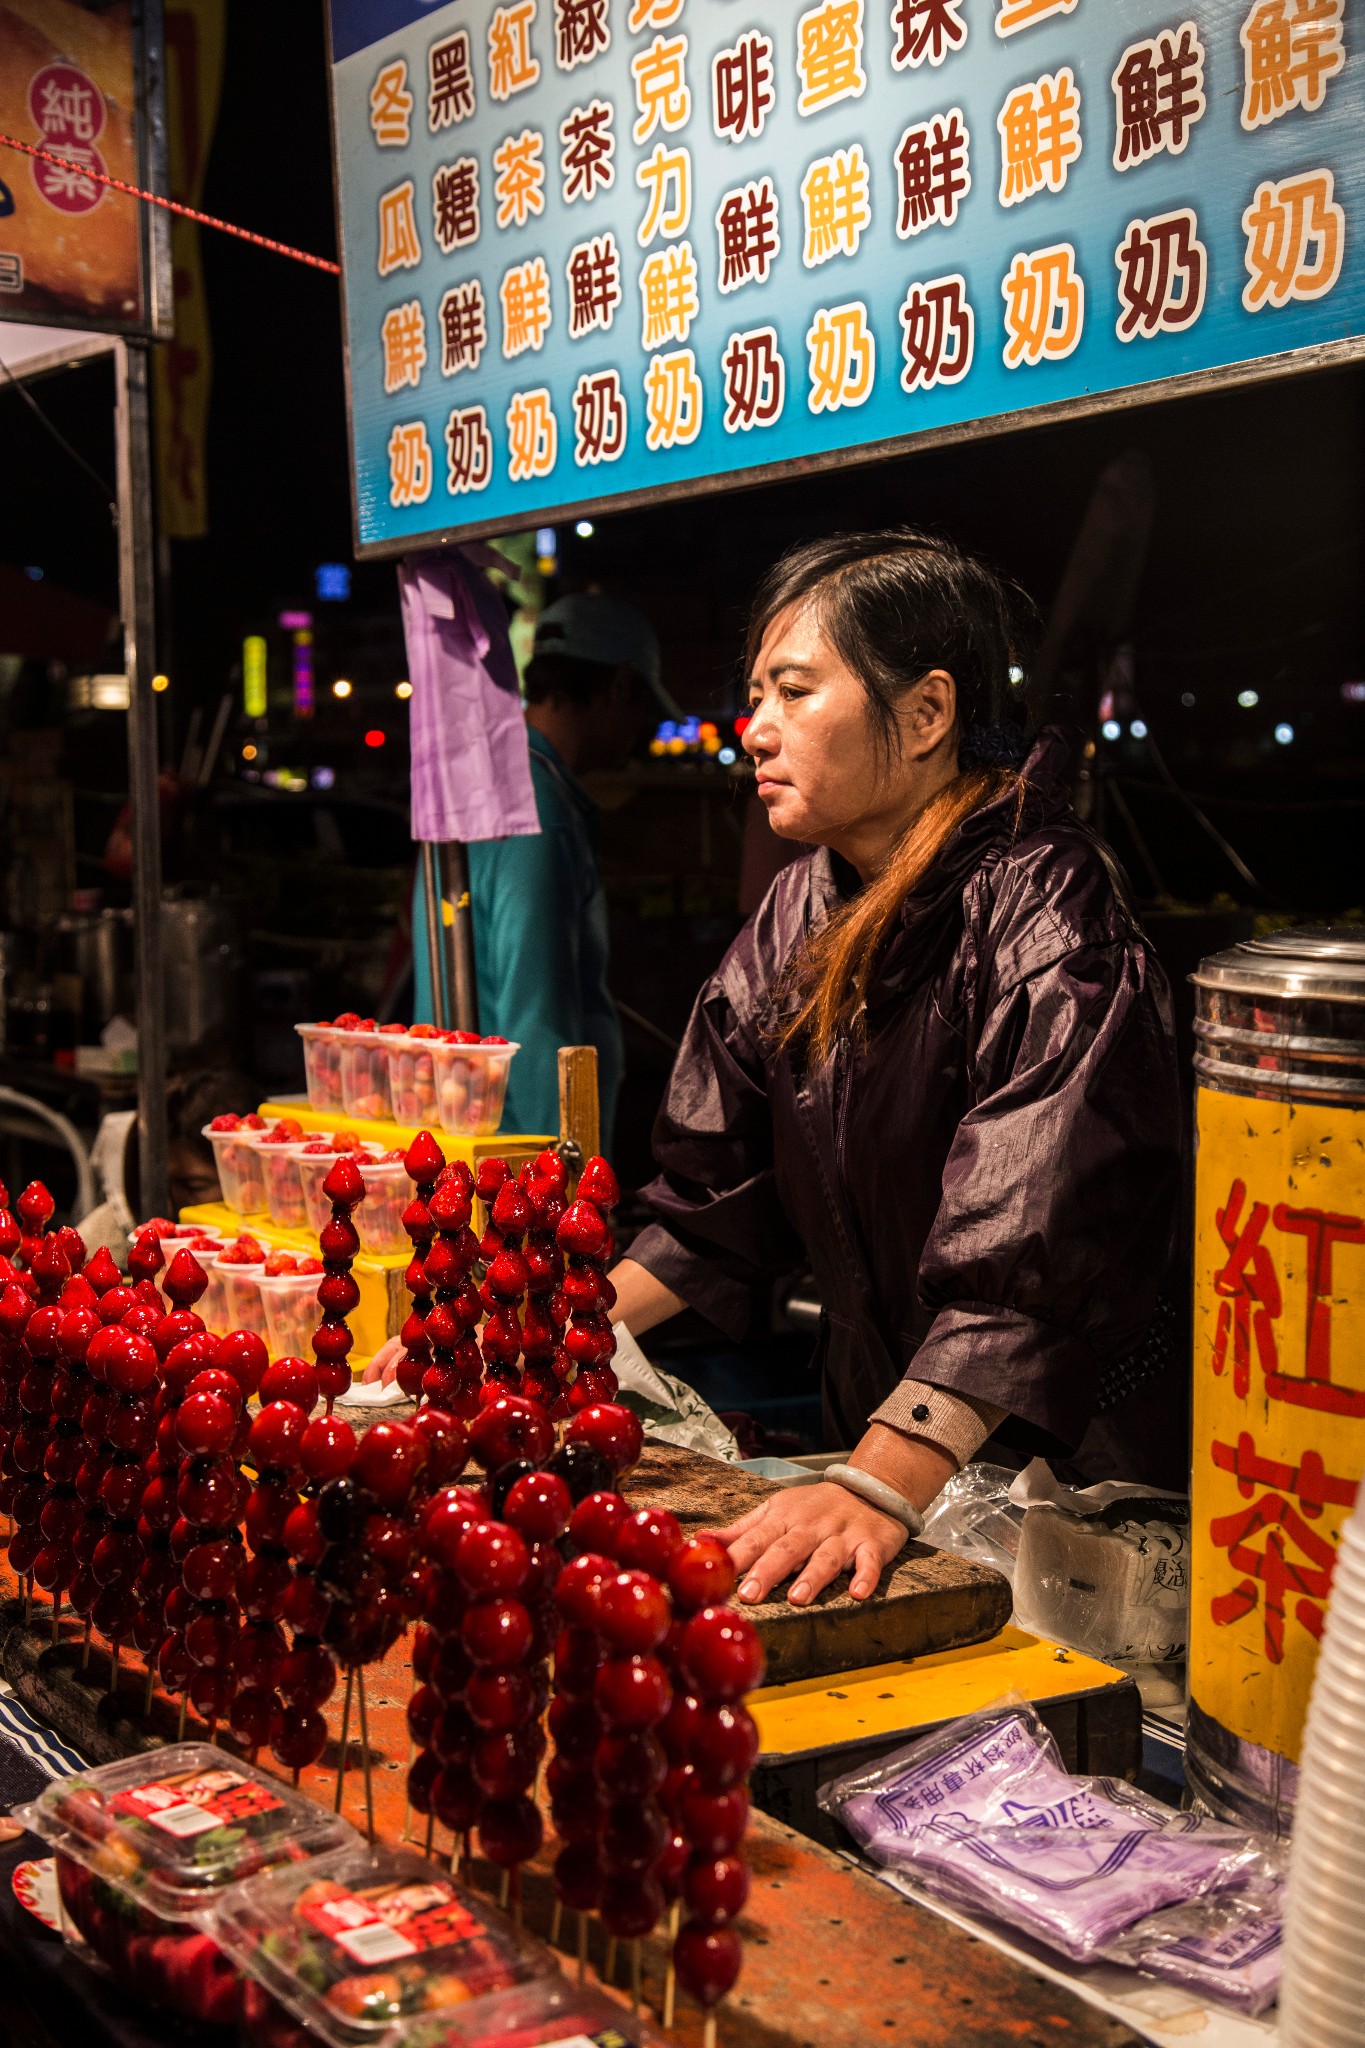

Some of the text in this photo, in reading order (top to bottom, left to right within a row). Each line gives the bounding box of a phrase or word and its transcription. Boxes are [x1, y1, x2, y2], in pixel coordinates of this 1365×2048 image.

[41, 80, 98, 201] 純素
[371, 66, 431, 503] 冬瓜鮮奶
[430, 37, 491, 490] 黑糖鮮奶
[490, 5, 554, 475] 紅茶鮮奶
[631, 0, 700, 443] 克力鮮奶
[999, 0, 1077, 361] 鮮奶
[1118, 30, 1201, 335] 鮮奶
[1246, 0, 1345, 304] 鮮奶
[1210, 1178, 1365, 1664] 紅茶
